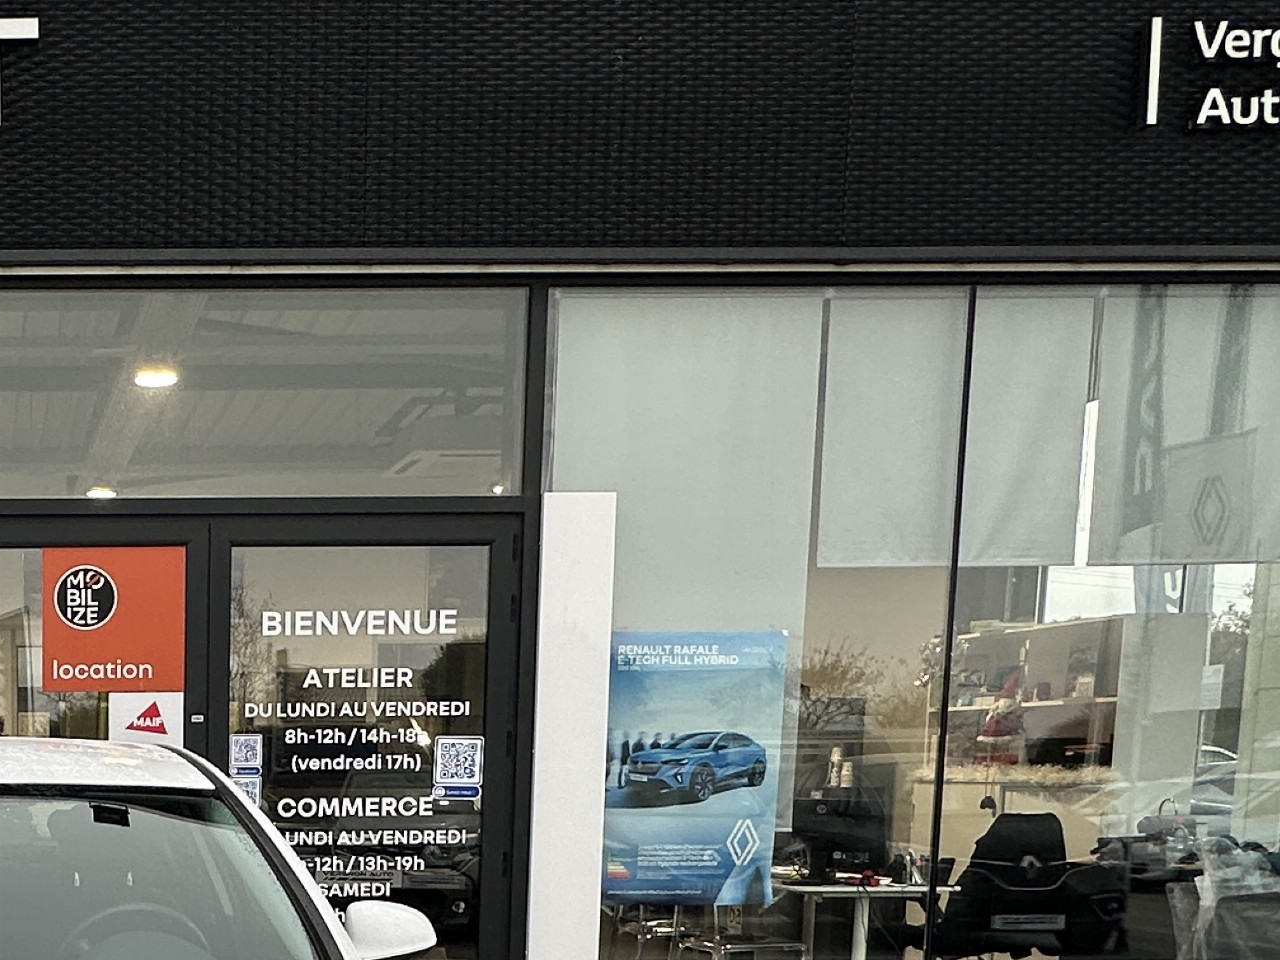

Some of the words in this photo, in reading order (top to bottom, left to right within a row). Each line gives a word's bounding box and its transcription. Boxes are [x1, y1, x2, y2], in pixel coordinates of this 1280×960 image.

[261, 609, 458, 636] BIENVENUE
[618, 645, 671, 655] RENAULT
[674, 645, 720, 655] RAFALE
[662, 655, 692, 664] FULL
[694, 655, 739, 664] HYBRID
[52, 659, 153, 680] location
[302, 667, 413, 688] ATELIER
[244, 703, 271, 718] DU
[276, 703, 335, 718] LUNDI
[339, 702, 367, 717] AU
[370, 701, 471, 716] VENDREDI
[133, 716, 164, 727] MAIF
[291, 755, 382, 772] (vendredi
[386, 755, 422, 772] 17h)
[277, 797, 433, 817] COMMERCE
[285, 831, 333, 846] UNDI
[337, 831, 365, 845] AU
[368, 829, 466, 845] VENDREDI
[318, 883, 390, 898] SAMEDI
